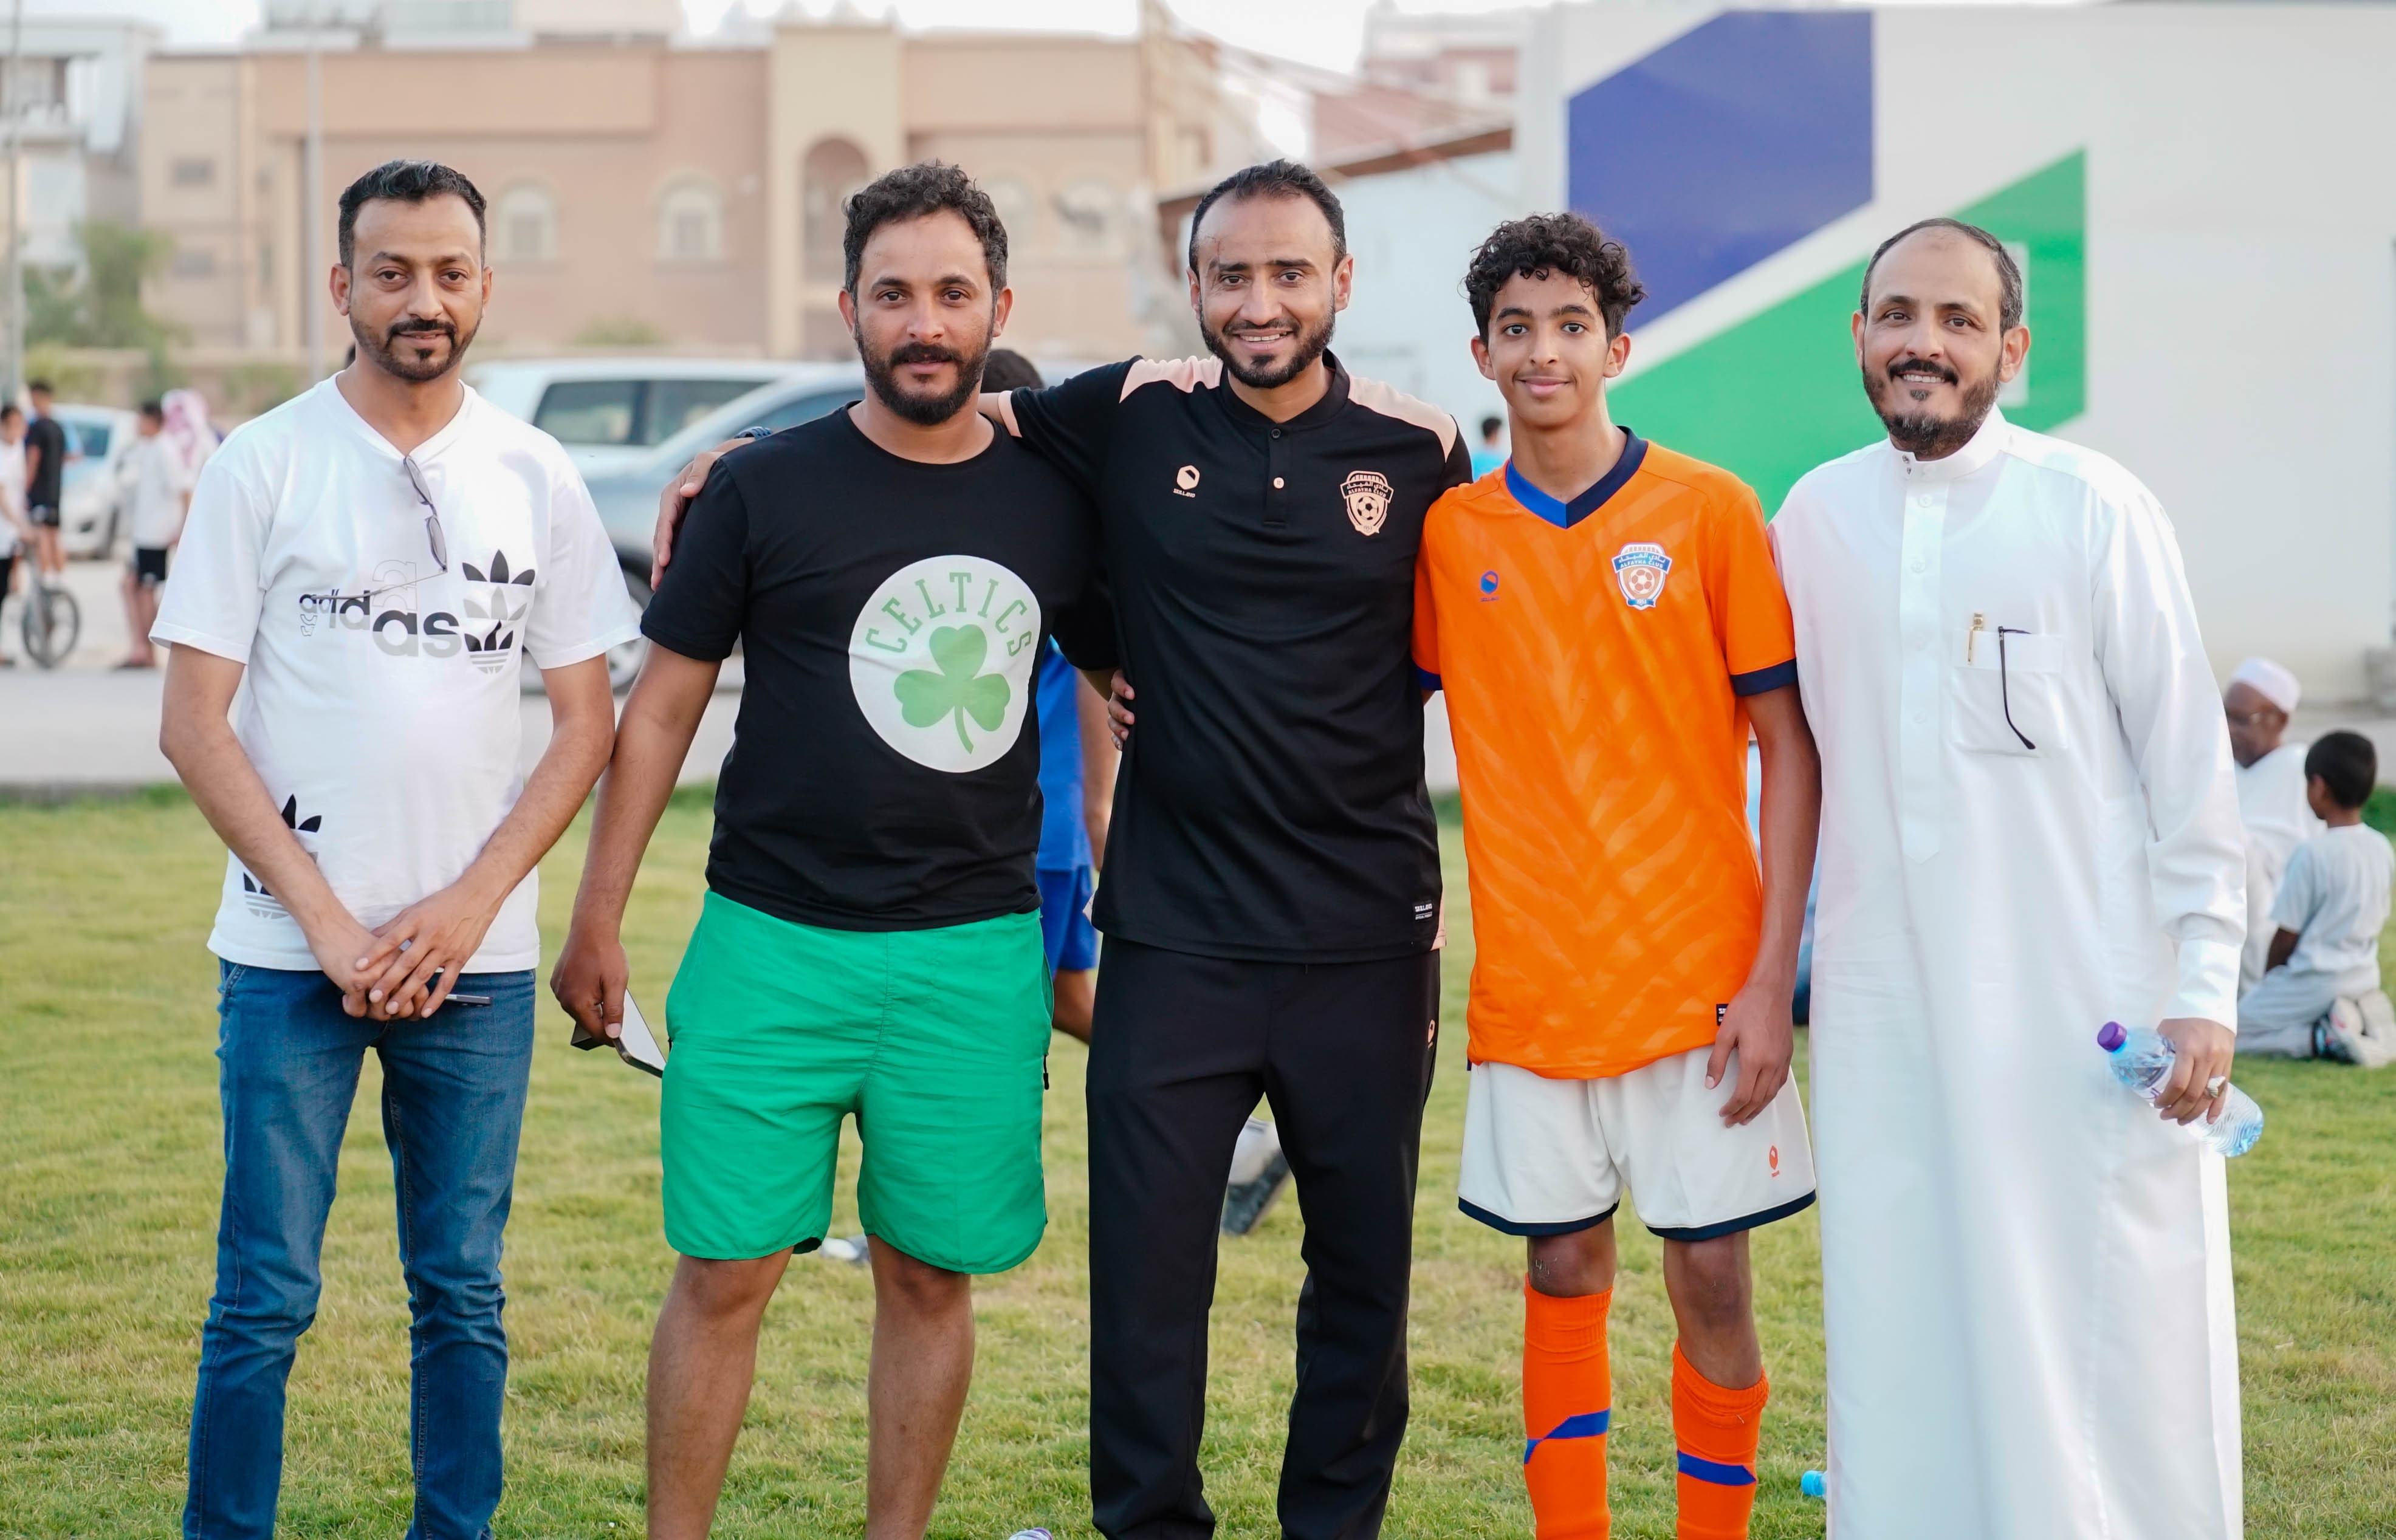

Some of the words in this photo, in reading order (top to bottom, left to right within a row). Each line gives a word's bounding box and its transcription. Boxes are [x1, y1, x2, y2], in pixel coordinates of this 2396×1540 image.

[1373, 490, 1387, 498] CLUB
[1648, 560, 1664, 569] CLUB
[865, 572, 1032, 657] CELTICS
